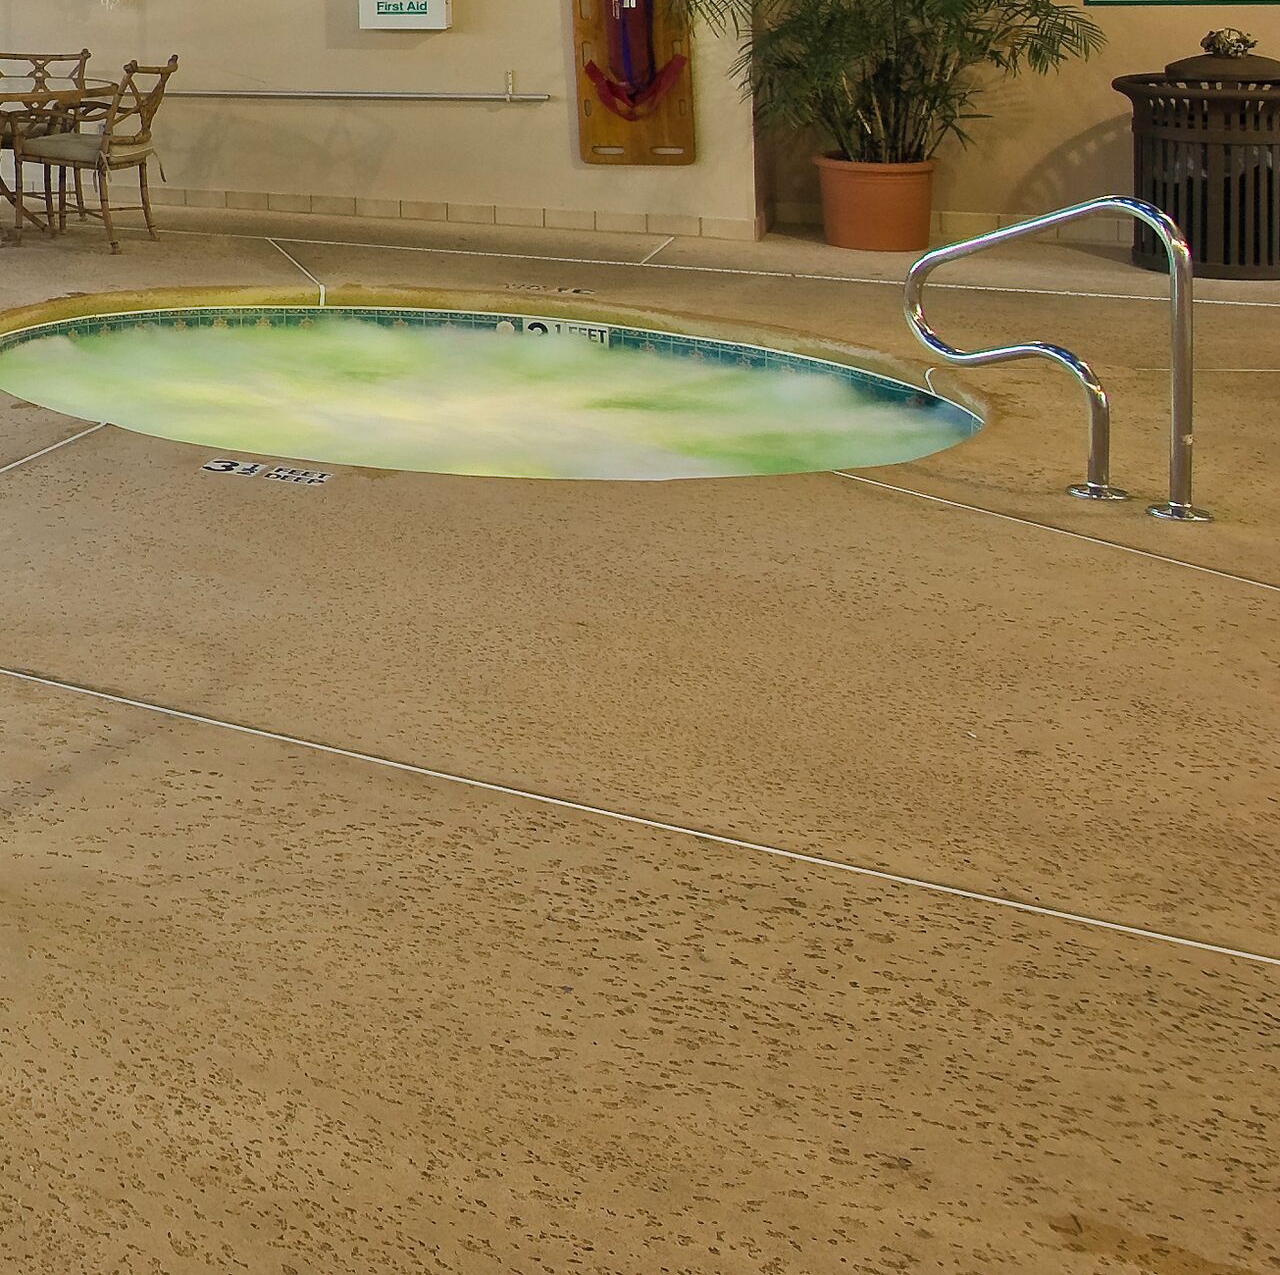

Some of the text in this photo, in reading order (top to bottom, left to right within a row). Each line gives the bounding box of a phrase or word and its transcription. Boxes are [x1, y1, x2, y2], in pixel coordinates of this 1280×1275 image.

[377, 1, 428, 11] First Aid
[264, 473, 325, 485] DEEP
[274, 467, 332, 479] FEET
